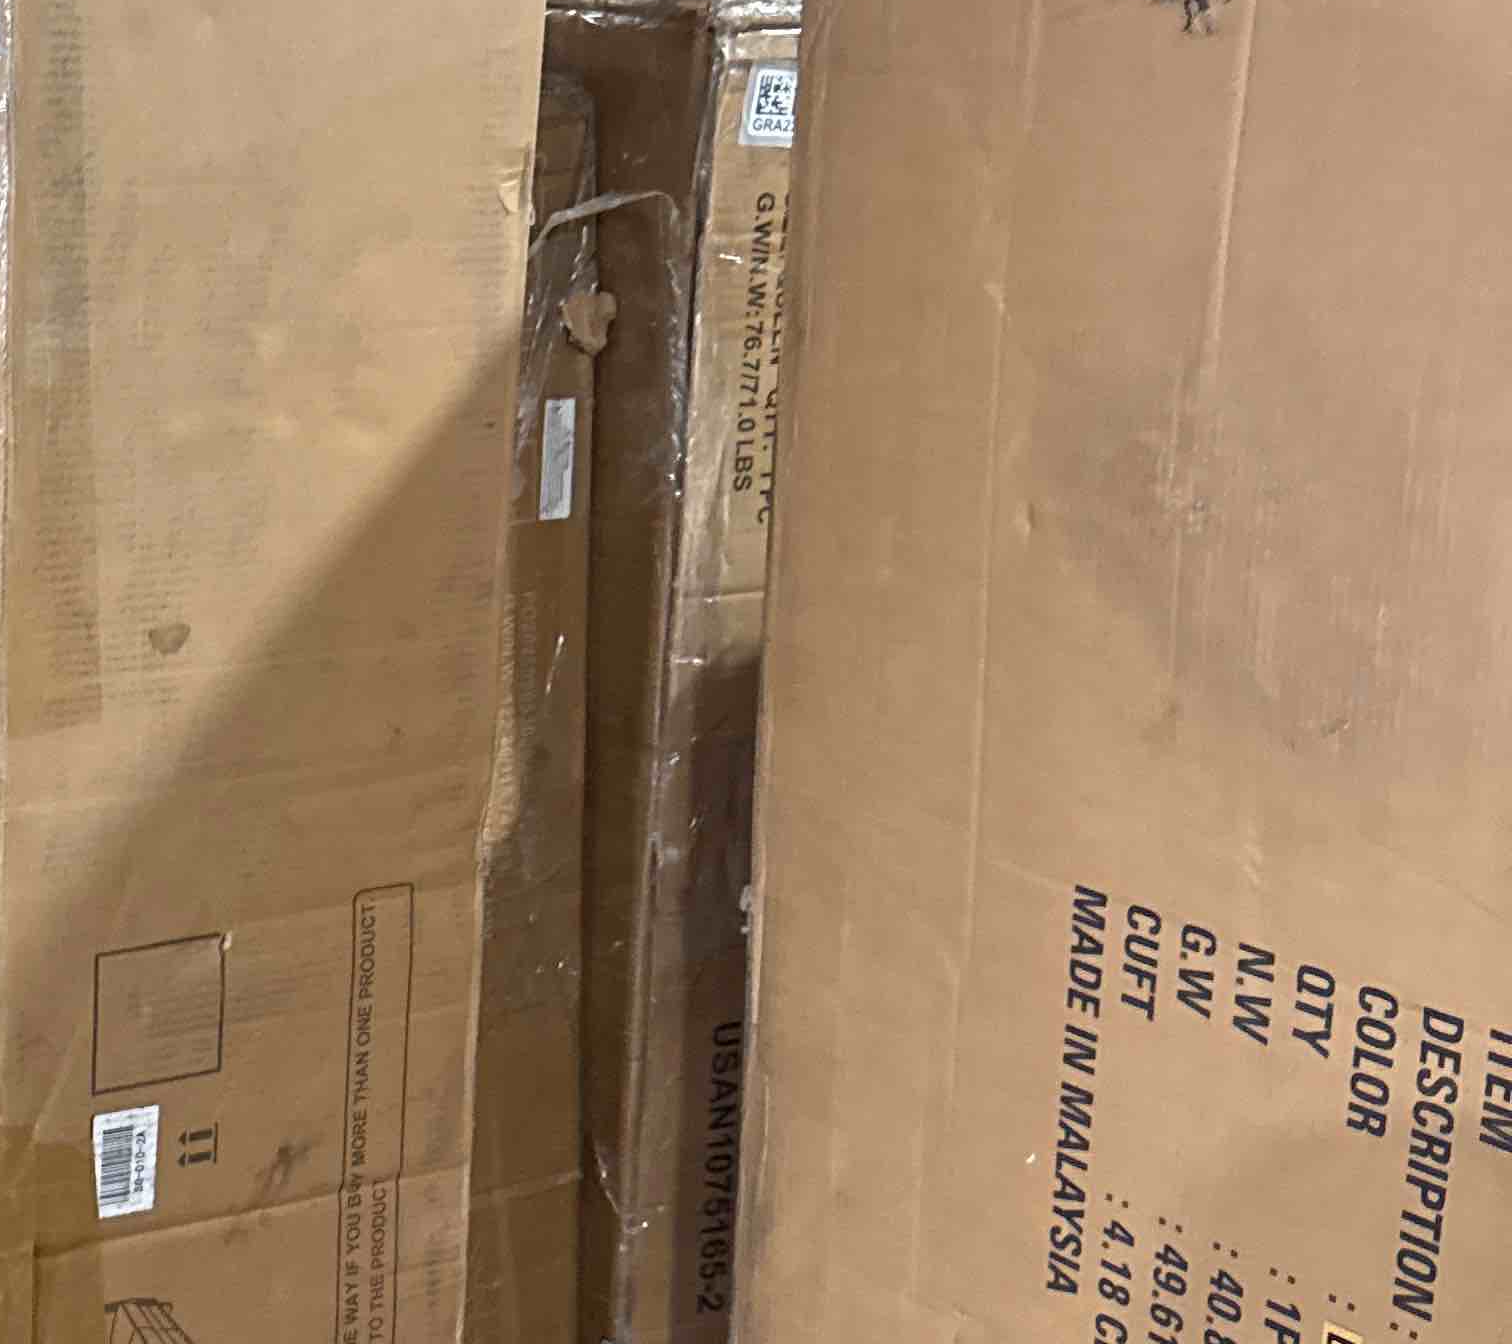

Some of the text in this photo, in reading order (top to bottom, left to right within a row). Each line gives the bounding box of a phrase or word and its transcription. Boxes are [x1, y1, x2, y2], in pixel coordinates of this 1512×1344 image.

[1120, 904, 1162, 1023] CUFT
[1176, 923, 1217, 1020] G.W
[1232, 942, 1275, 1047] N.W
[356, 1005, 373, 1047] ONE
[1291, 963, 1336, 1058] QTY
[353, 1051, 369, 1104] THAN
[1046, 884, 1108, 1296] MADE IN MALAYSIA
[1346, 985, 1399, 1138] COLOR
[351, 1109, 368, 1167] MORE
[1391, 1006, 1464, 1321] DESCRIPTION
[345, 1261, 359, 1277] IF
[346, 1214, 361, 1256] YOU
[1097, 1220, 1135, 1307] 4.18
[344, 1283, 359, 1327] WAY
[369, 1273, 385, 1315] THE
[368, 1317, 383, 1344] TO
